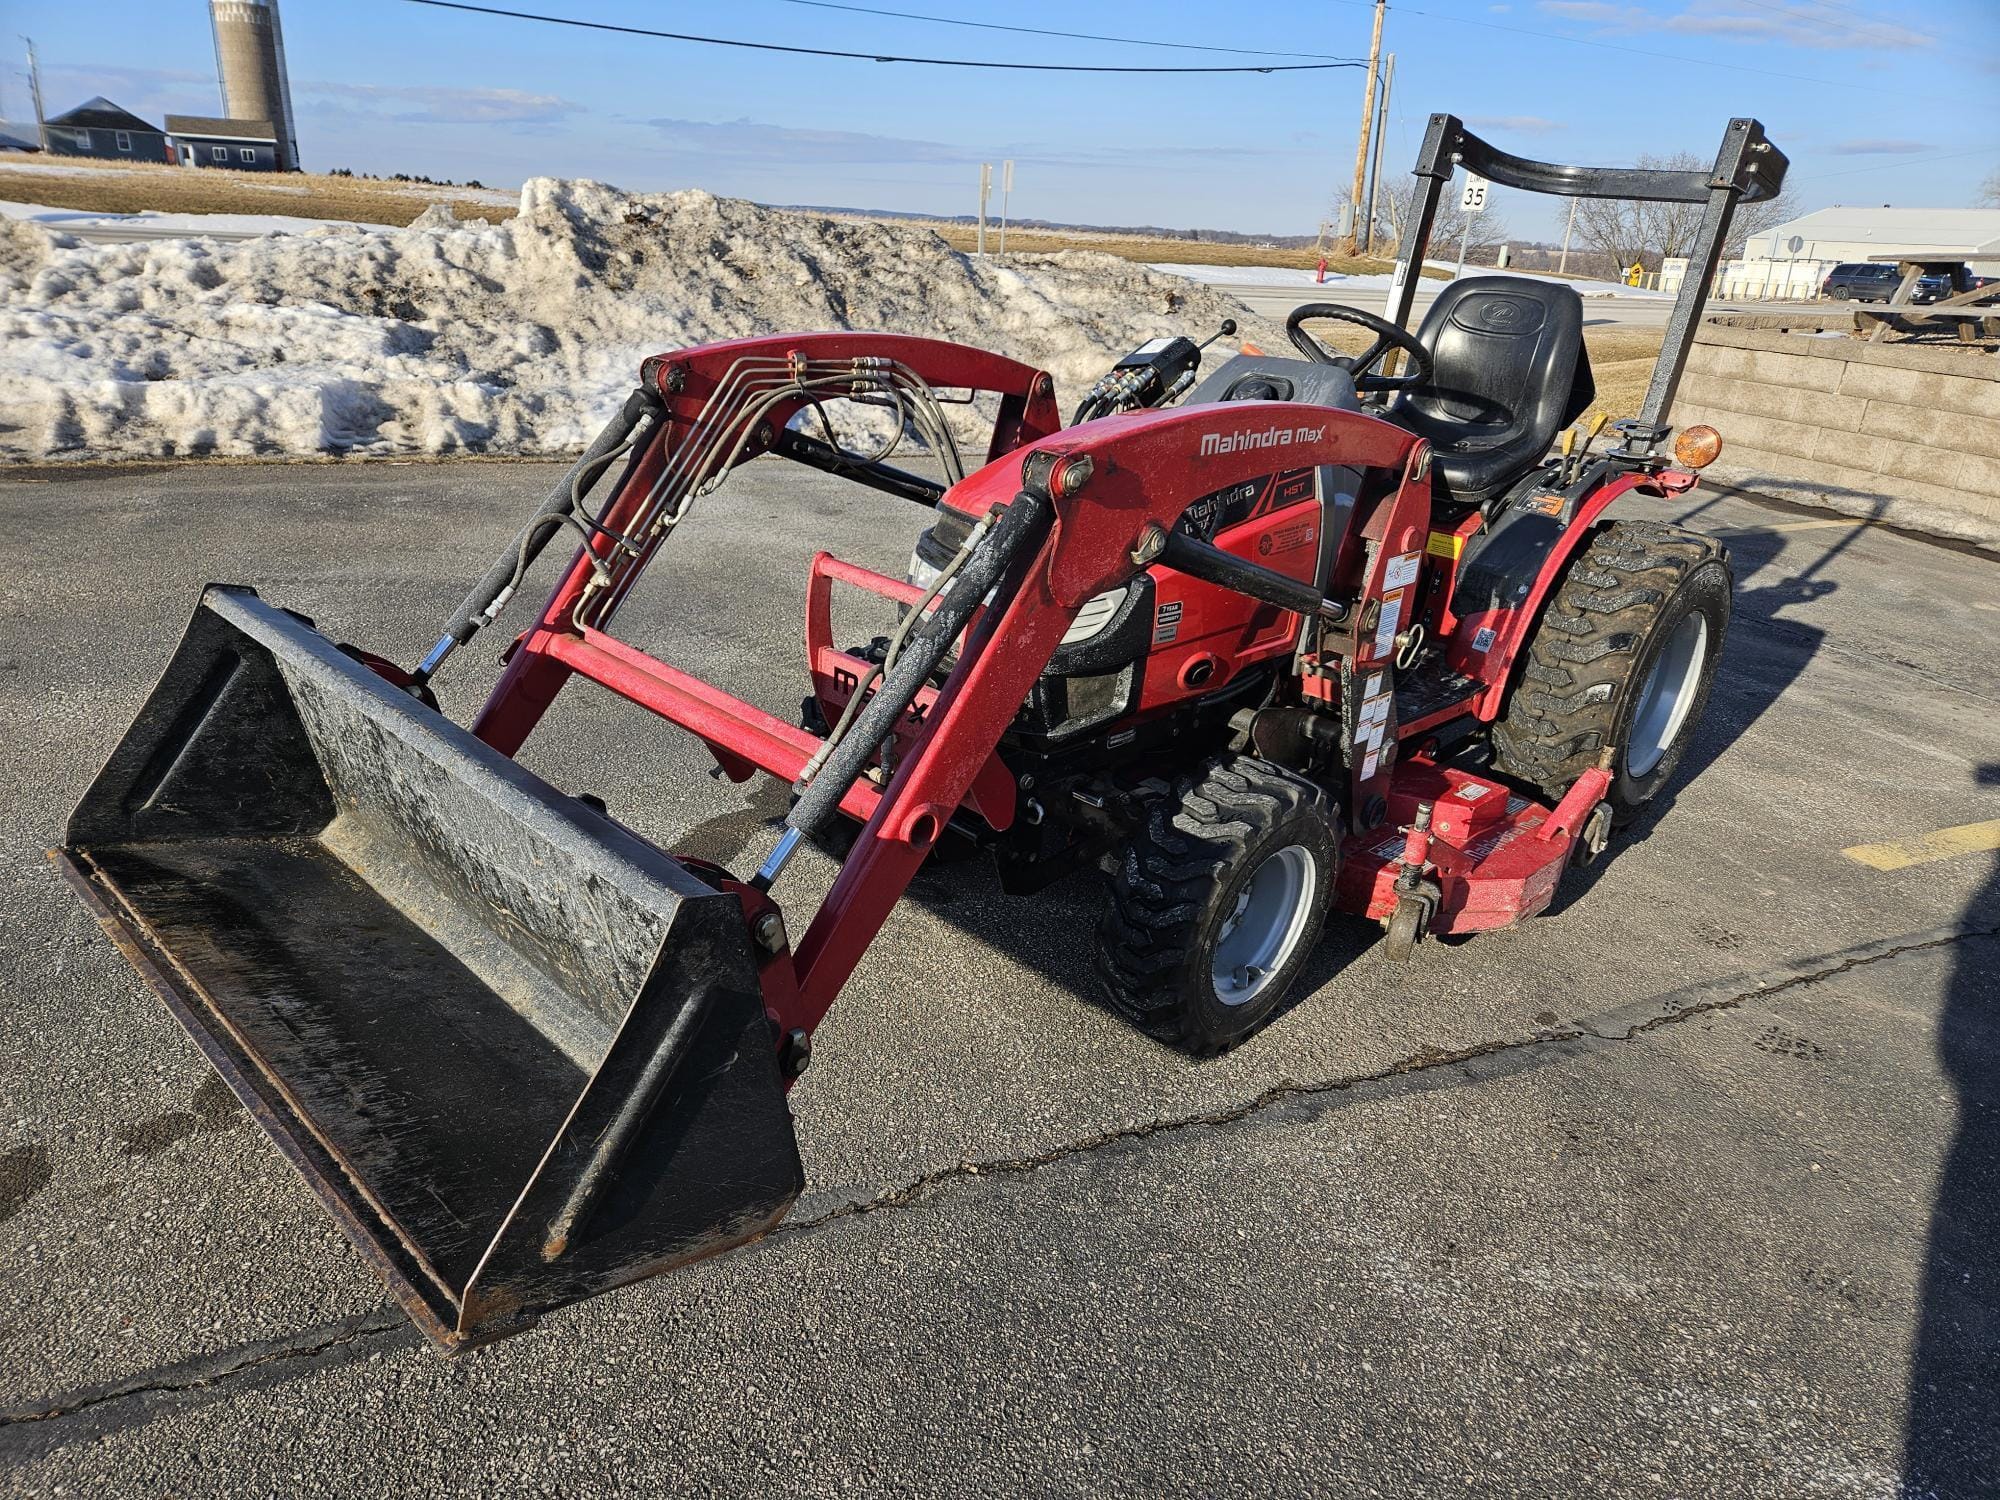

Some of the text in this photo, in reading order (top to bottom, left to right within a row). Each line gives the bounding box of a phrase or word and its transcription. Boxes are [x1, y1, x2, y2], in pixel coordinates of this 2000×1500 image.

[1464, 188, 1484, 206] 35
[1200, 427, 1293, 456] Mahindra
[1284, 482, 1305, 497] HST
